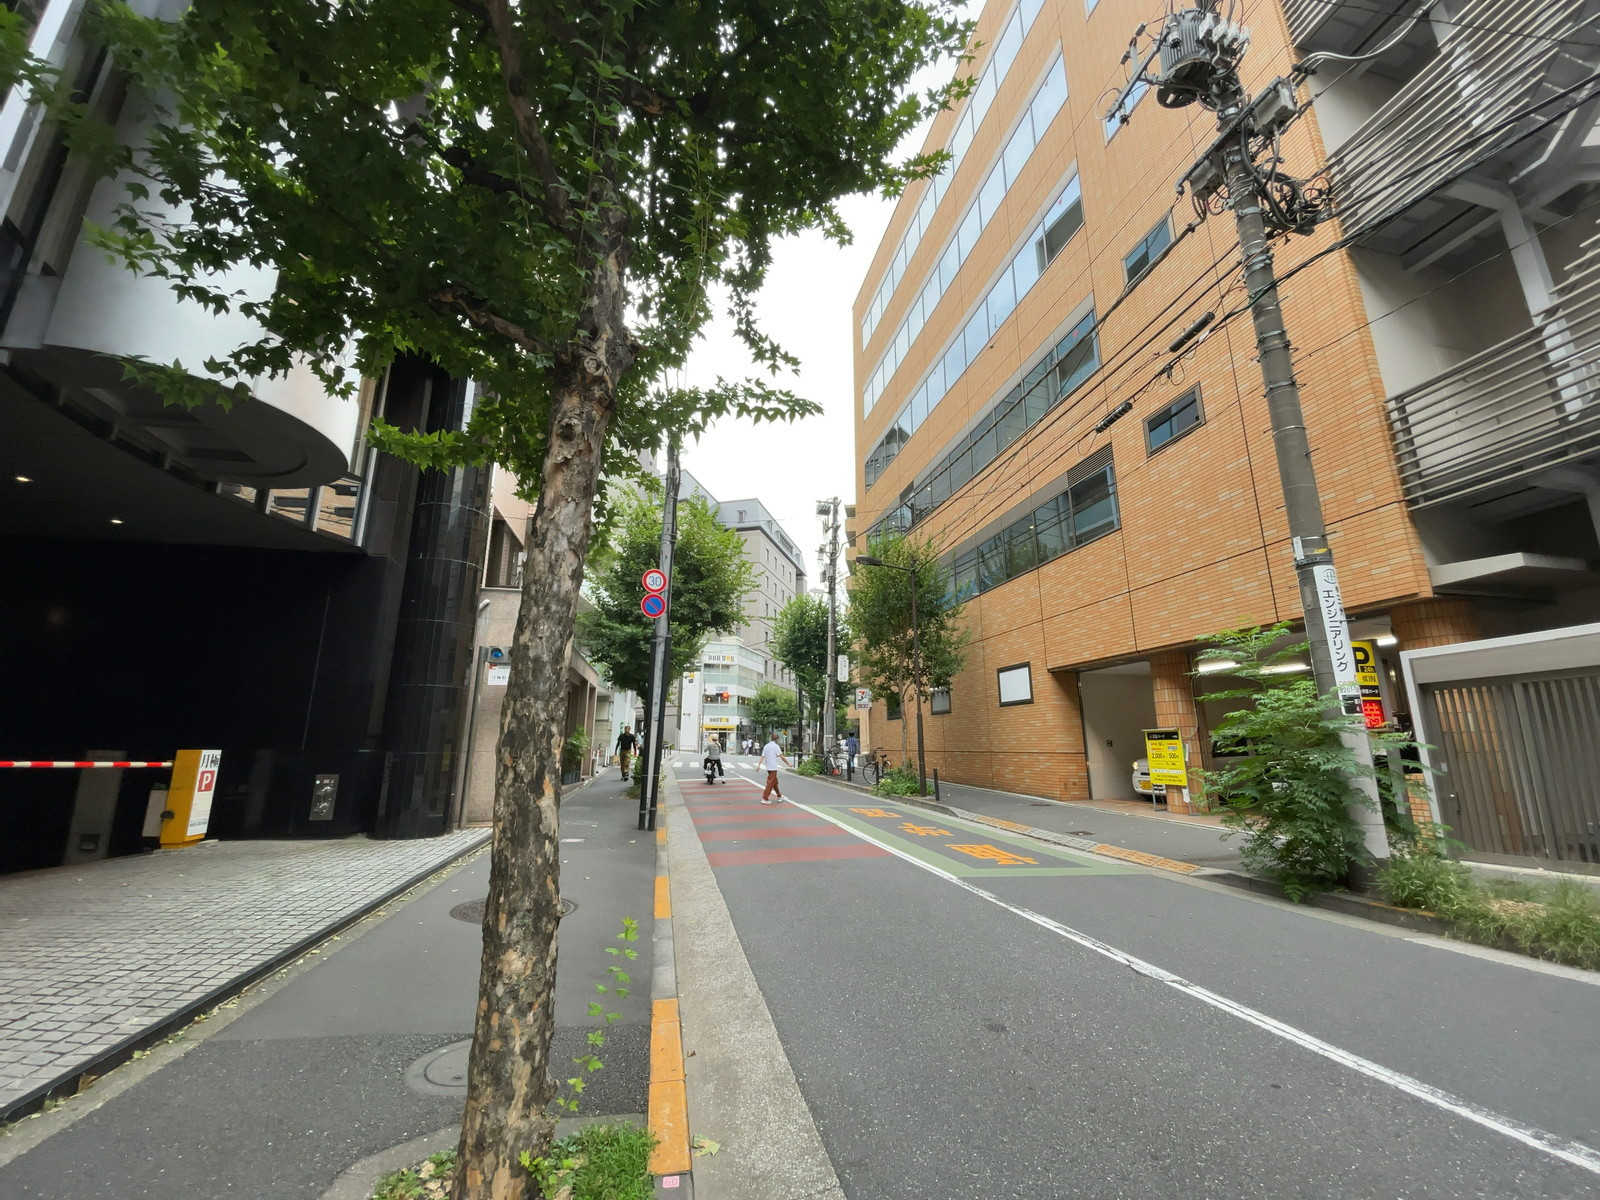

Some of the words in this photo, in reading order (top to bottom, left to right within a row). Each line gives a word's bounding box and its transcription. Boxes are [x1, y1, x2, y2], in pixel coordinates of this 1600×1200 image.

[648, 575, 662, 587] 30
[1322, 589, 1349, 673] エンジニアリング
[1352, 646, 1370, 673] P
[201, 754, 221, 769] 月極
[201, 772, 212, 791] P
